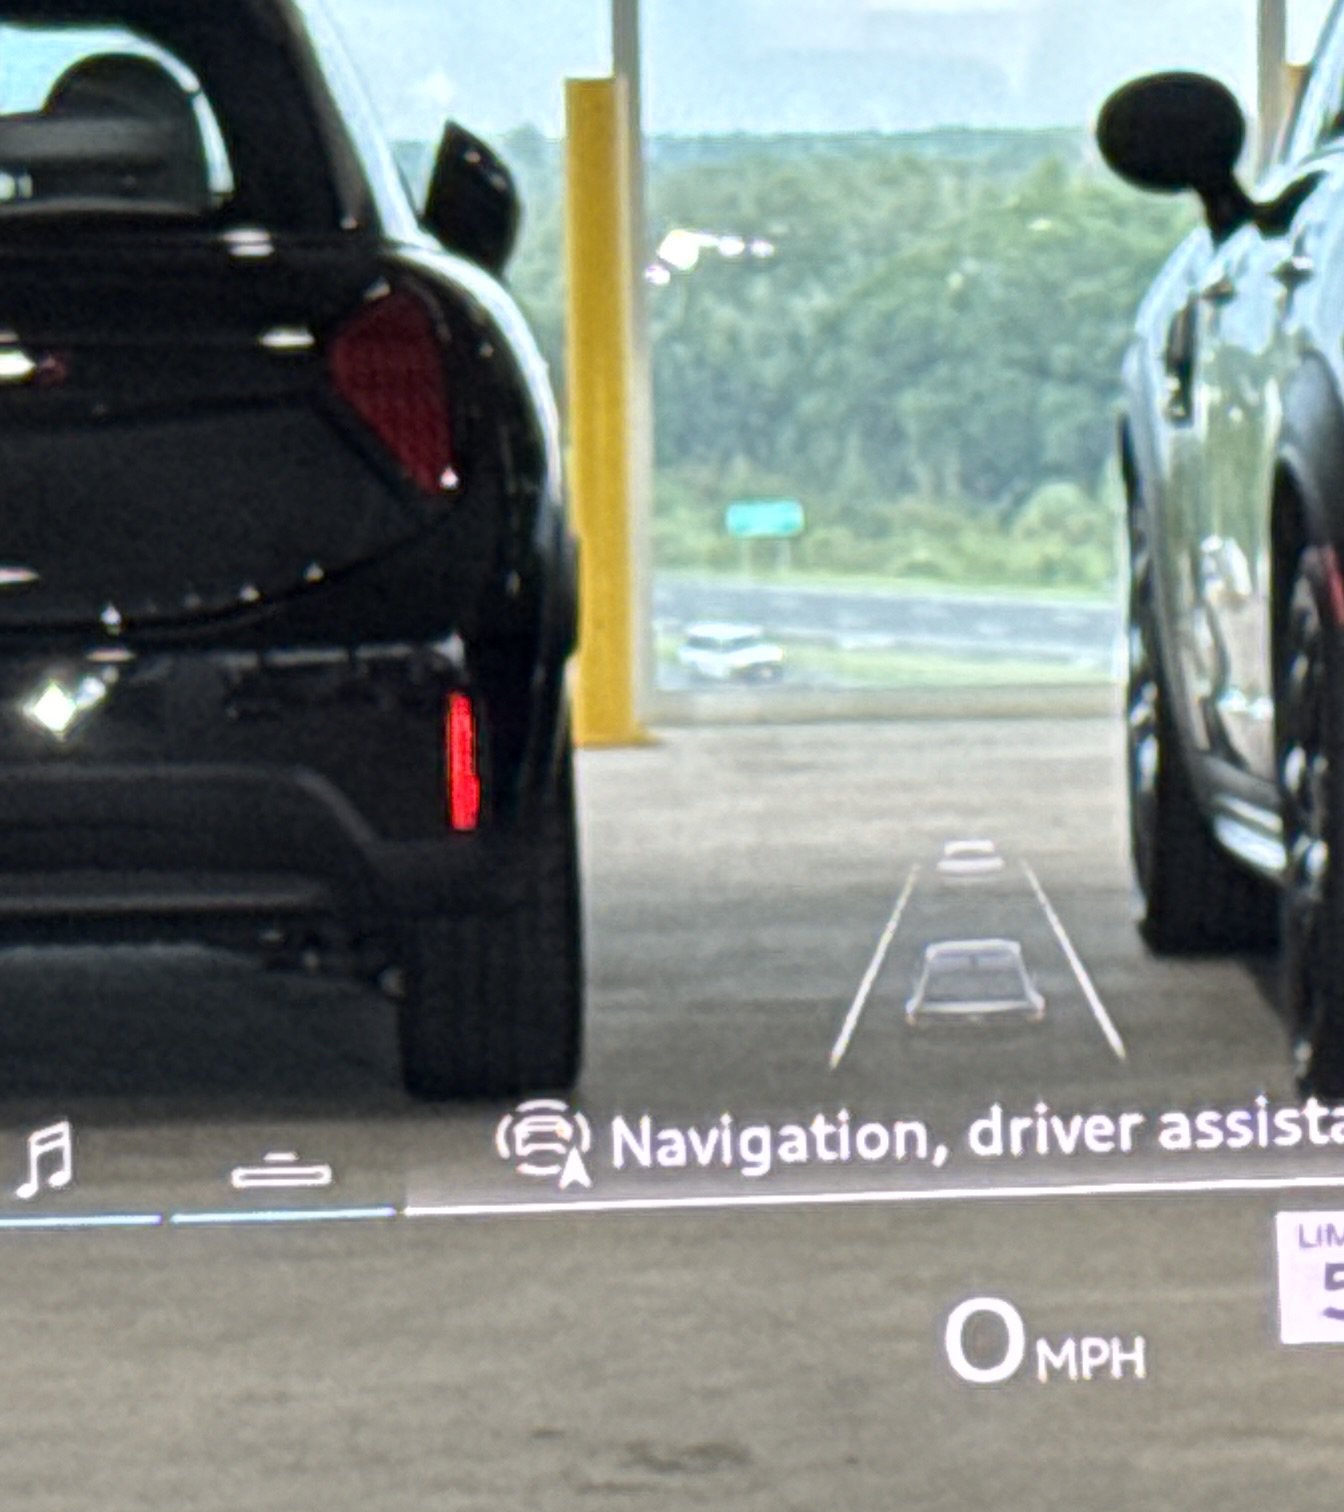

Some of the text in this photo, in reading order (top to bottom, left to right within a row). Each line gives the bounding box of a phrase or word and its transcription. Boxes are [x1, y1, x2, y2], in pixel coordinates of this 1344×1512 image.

[611, 1109, 949, 1178] Navigation,
[967, 1101, 1145, 1157] driver
[944, 1296, 1147, 1383] 0 MPH
